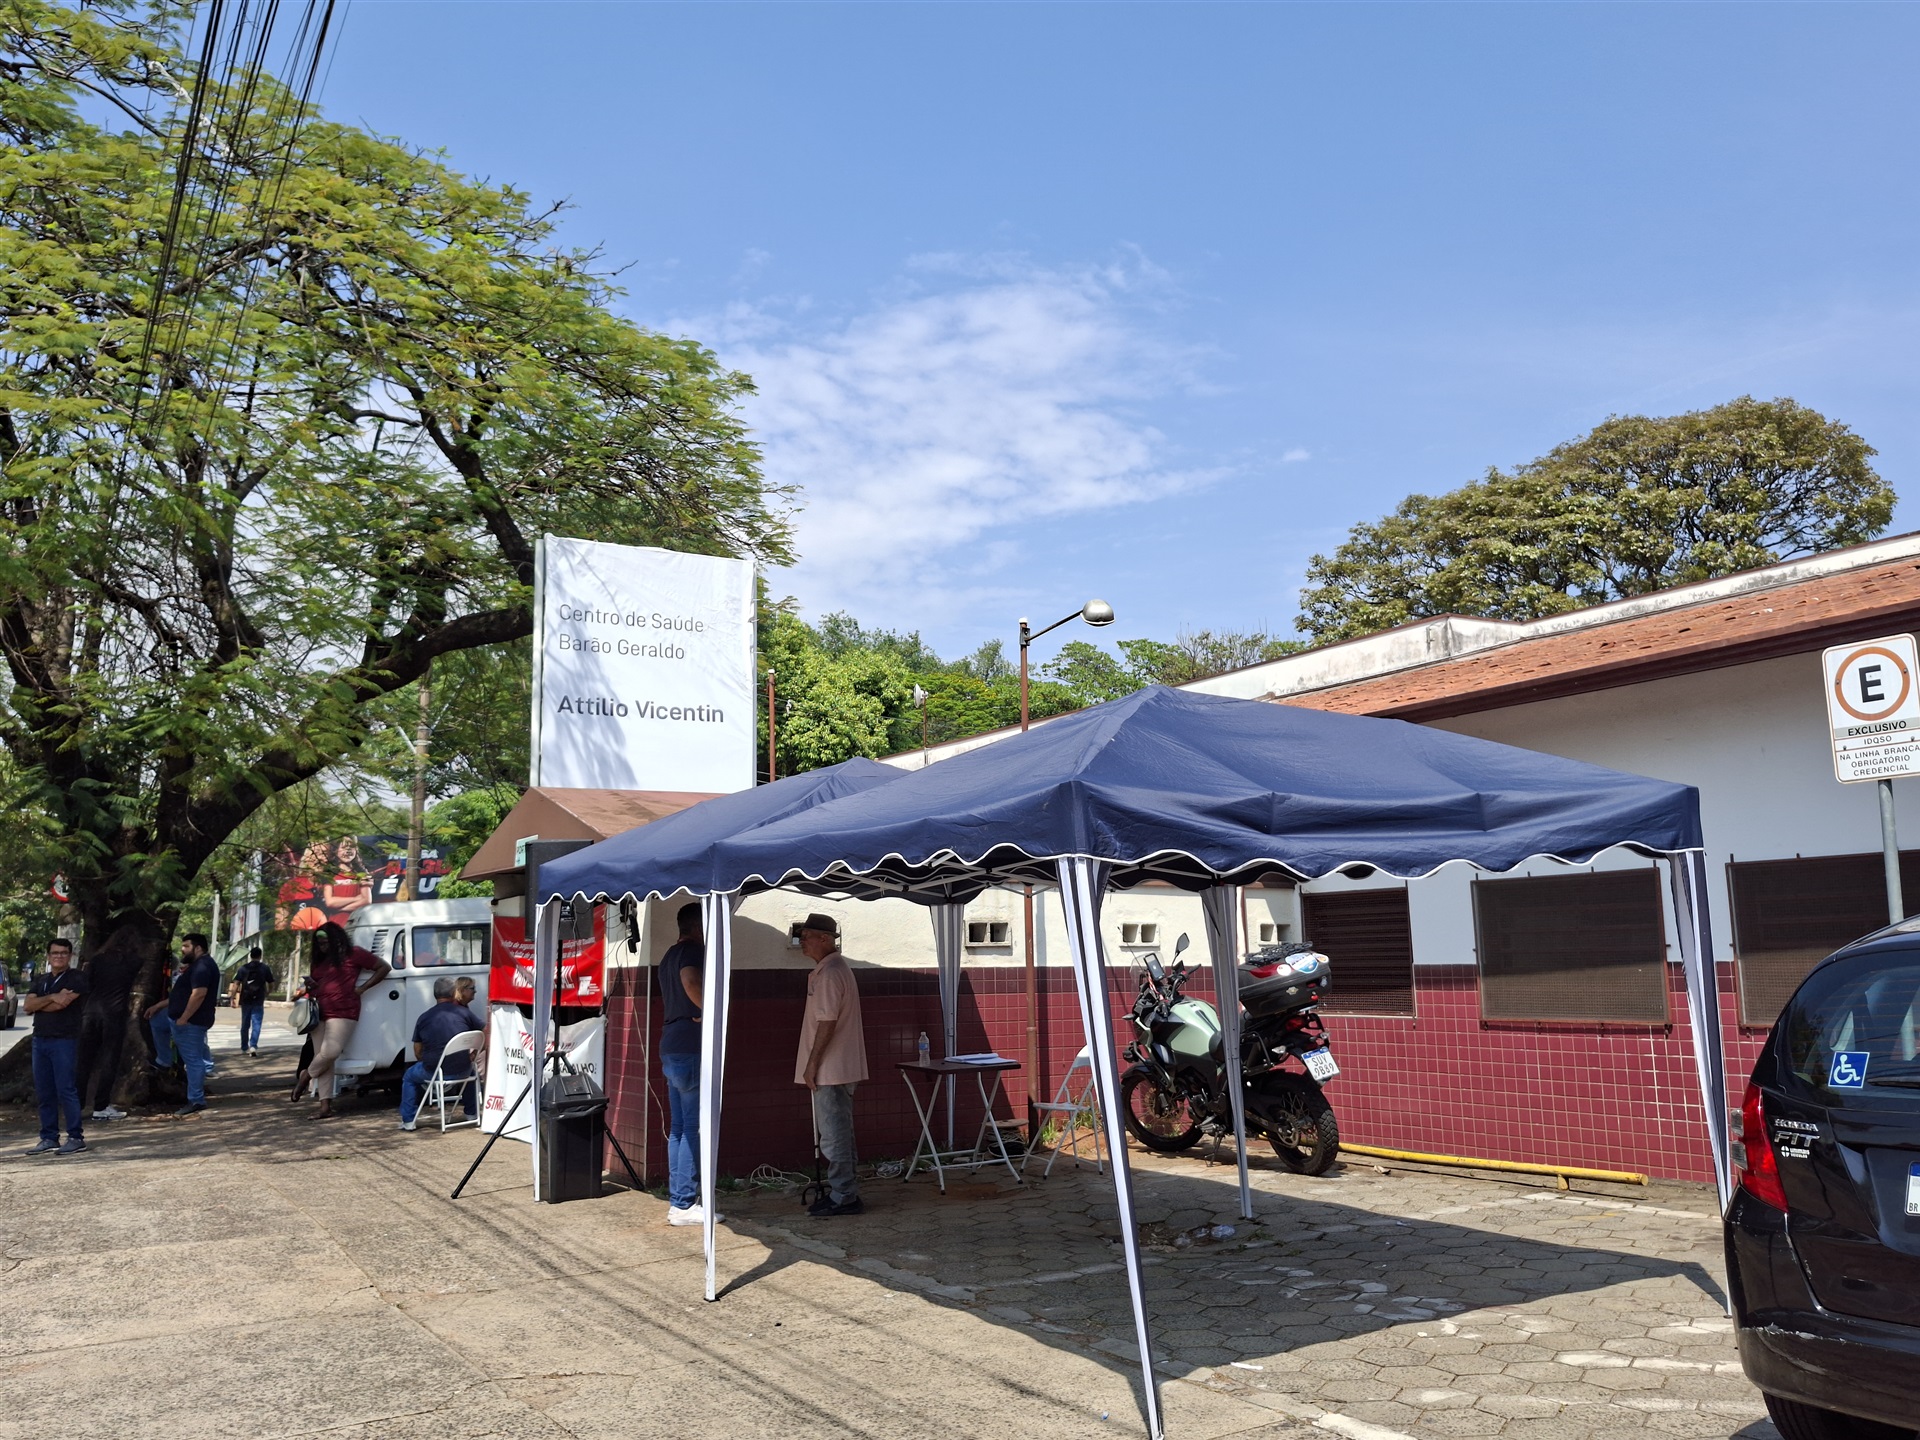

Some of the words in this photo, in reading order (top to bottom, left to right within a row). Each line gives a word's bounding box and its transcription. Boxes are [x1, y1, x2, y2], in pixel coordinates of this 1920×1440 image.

[559, 603, 620, 626] Centro
[625, 611, 647, 628] de
[651, 612, 705, 633] Saúde
[559, 633, 612, 654] Barão
[617, 638, 686, 660] Geraldo
[1858, 664, 1885, 703] E
[557, 695, 629, 718] Attilio
[635, 699, 725, 723] Vicentin
[1847, 720, 1907, 737] EXCLUSIVO
[1839, 753, 1851, 761] NA
[1854, 749, 1880, 759] LINHA
[1884, 744, 1920, 755] BRANCA
[1851, 754, 1911, 768] OBRIGATÓRIO
[1853, 764, 1910, 777] CREDENCIAL
[379, 874, 399, 894] É
[1774, 1118, 1819, 1132] HONDA
[1774, 1130, 1820, 1147] FIT
[1908, 1202, 1919, 1212] BR
